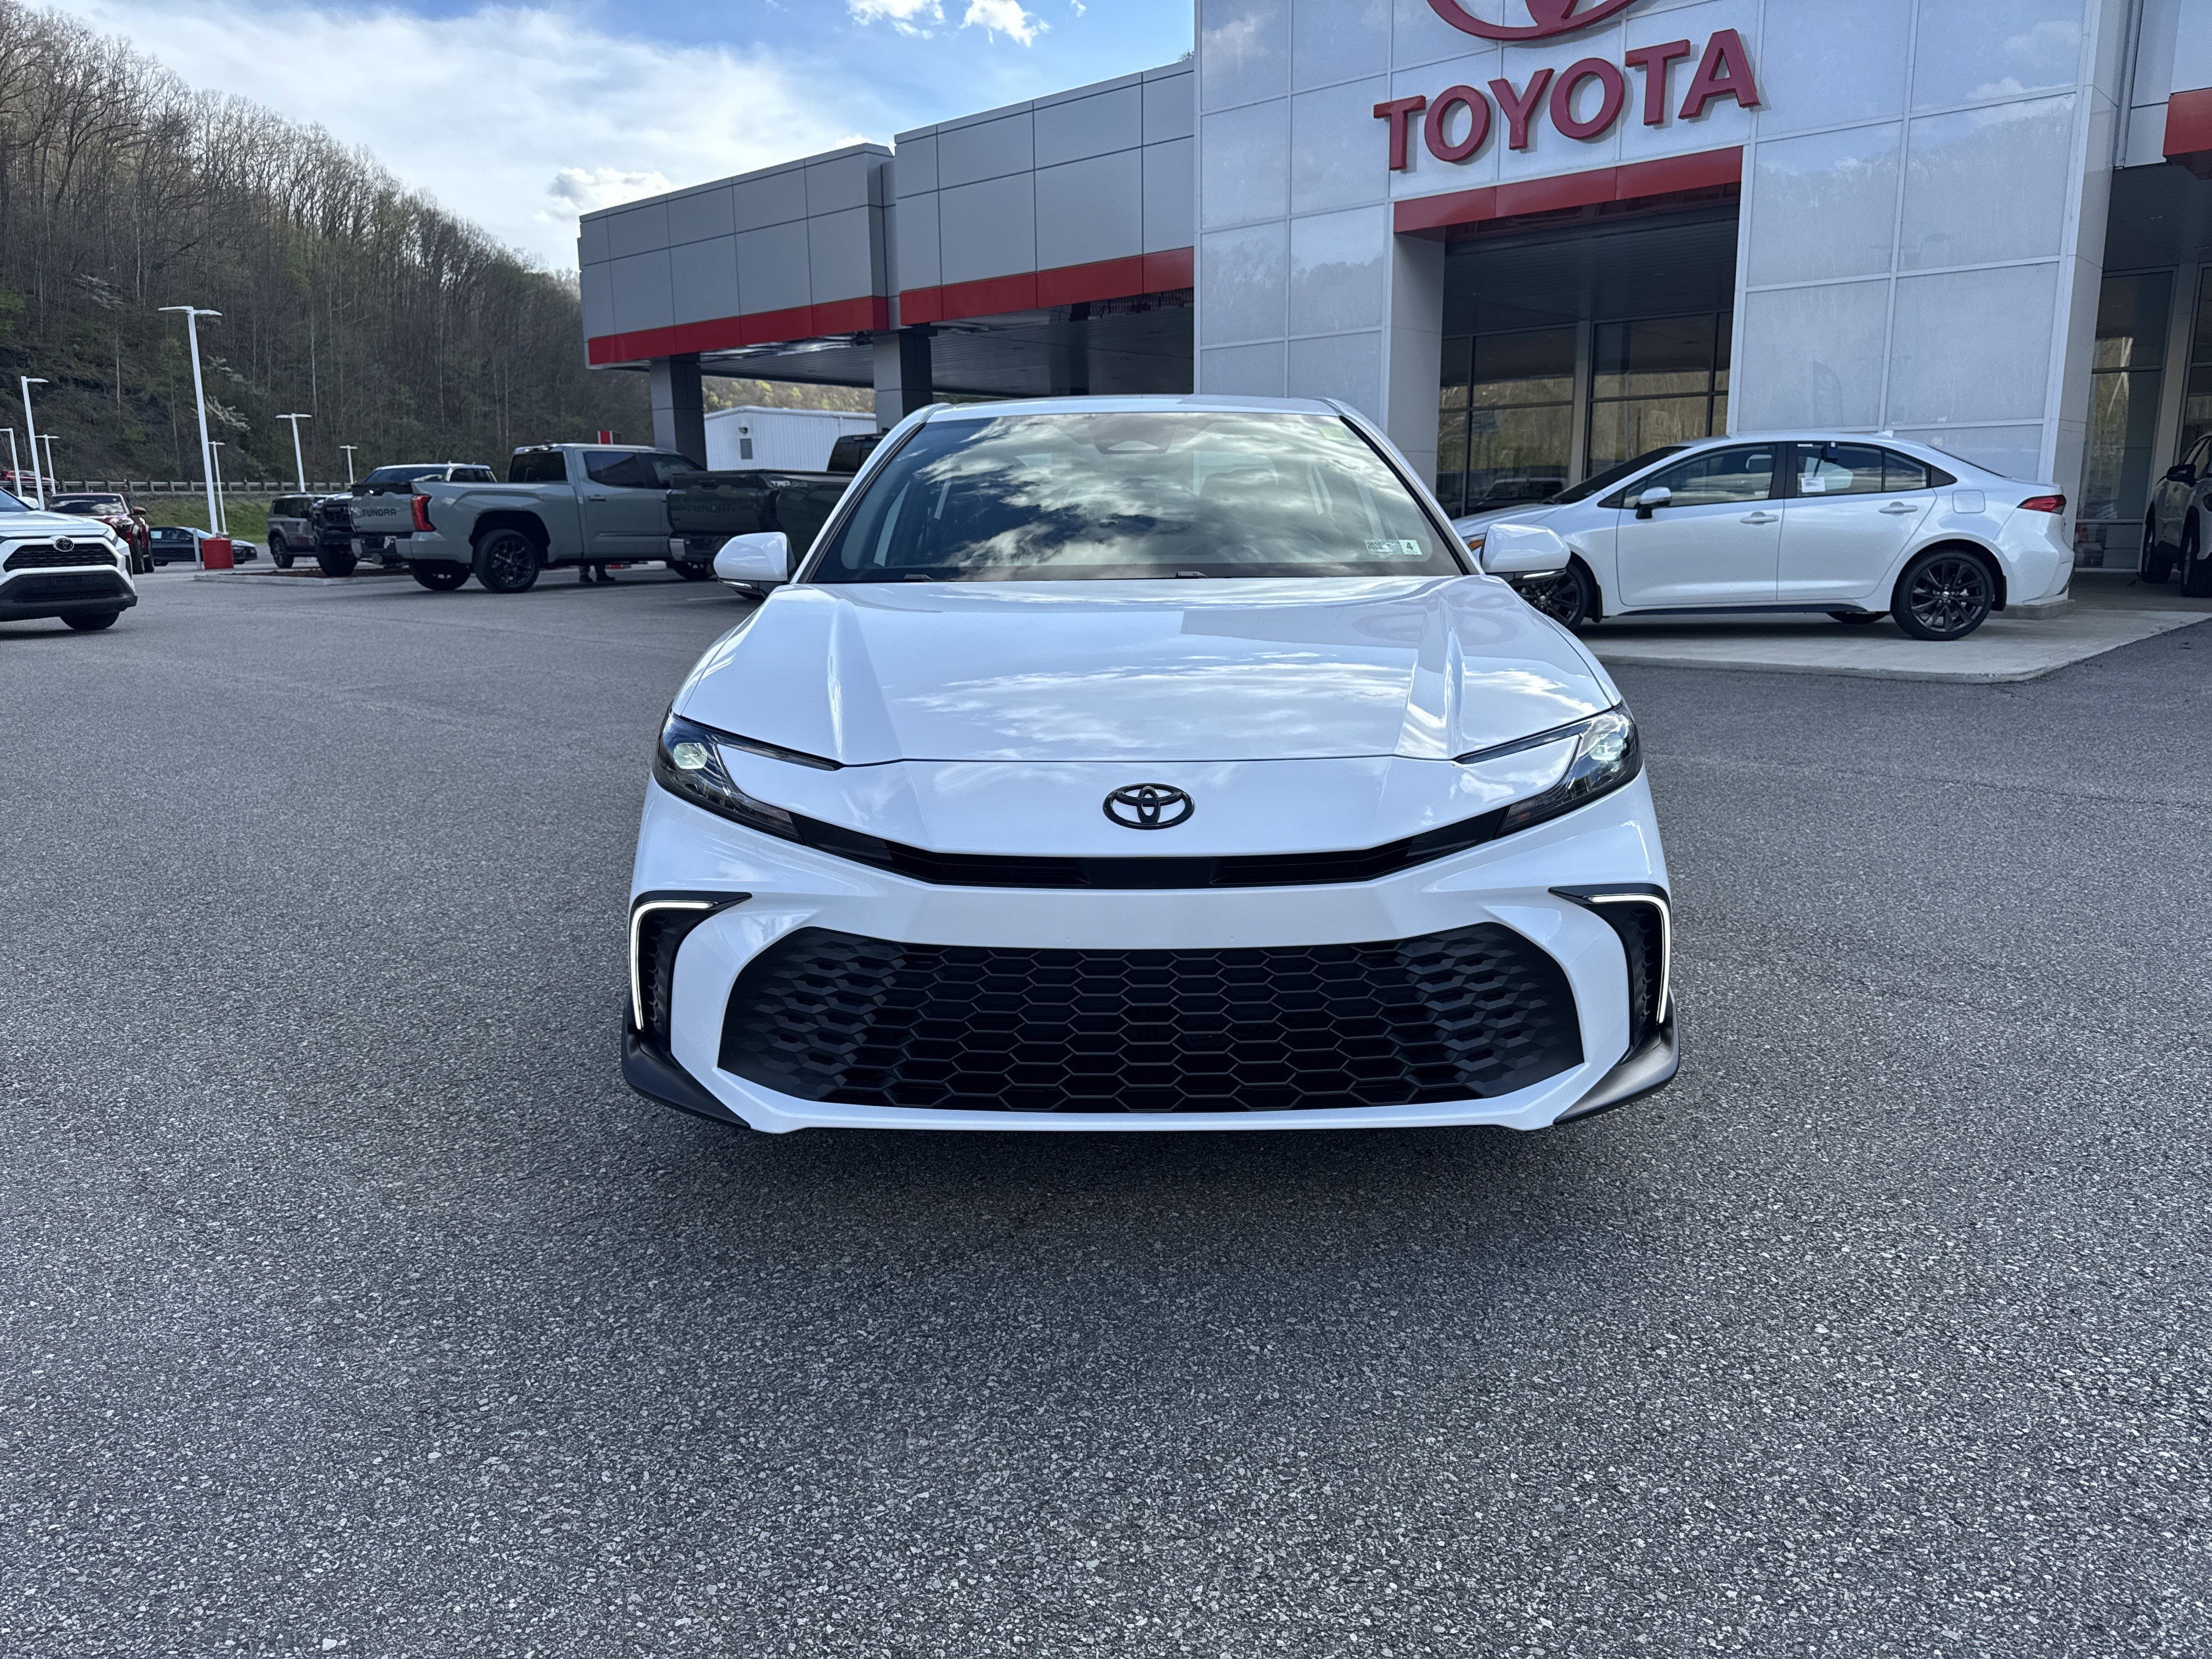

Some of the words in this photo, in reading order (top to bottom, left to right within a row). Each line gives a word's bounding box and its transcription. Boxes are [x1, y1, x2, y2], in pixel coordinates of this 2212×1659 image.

[1374, 28, 1762, 171] TOYOTA
[362, 508, 397, 517] TUNDRA
[1407, 542, 1413, 550] 4
